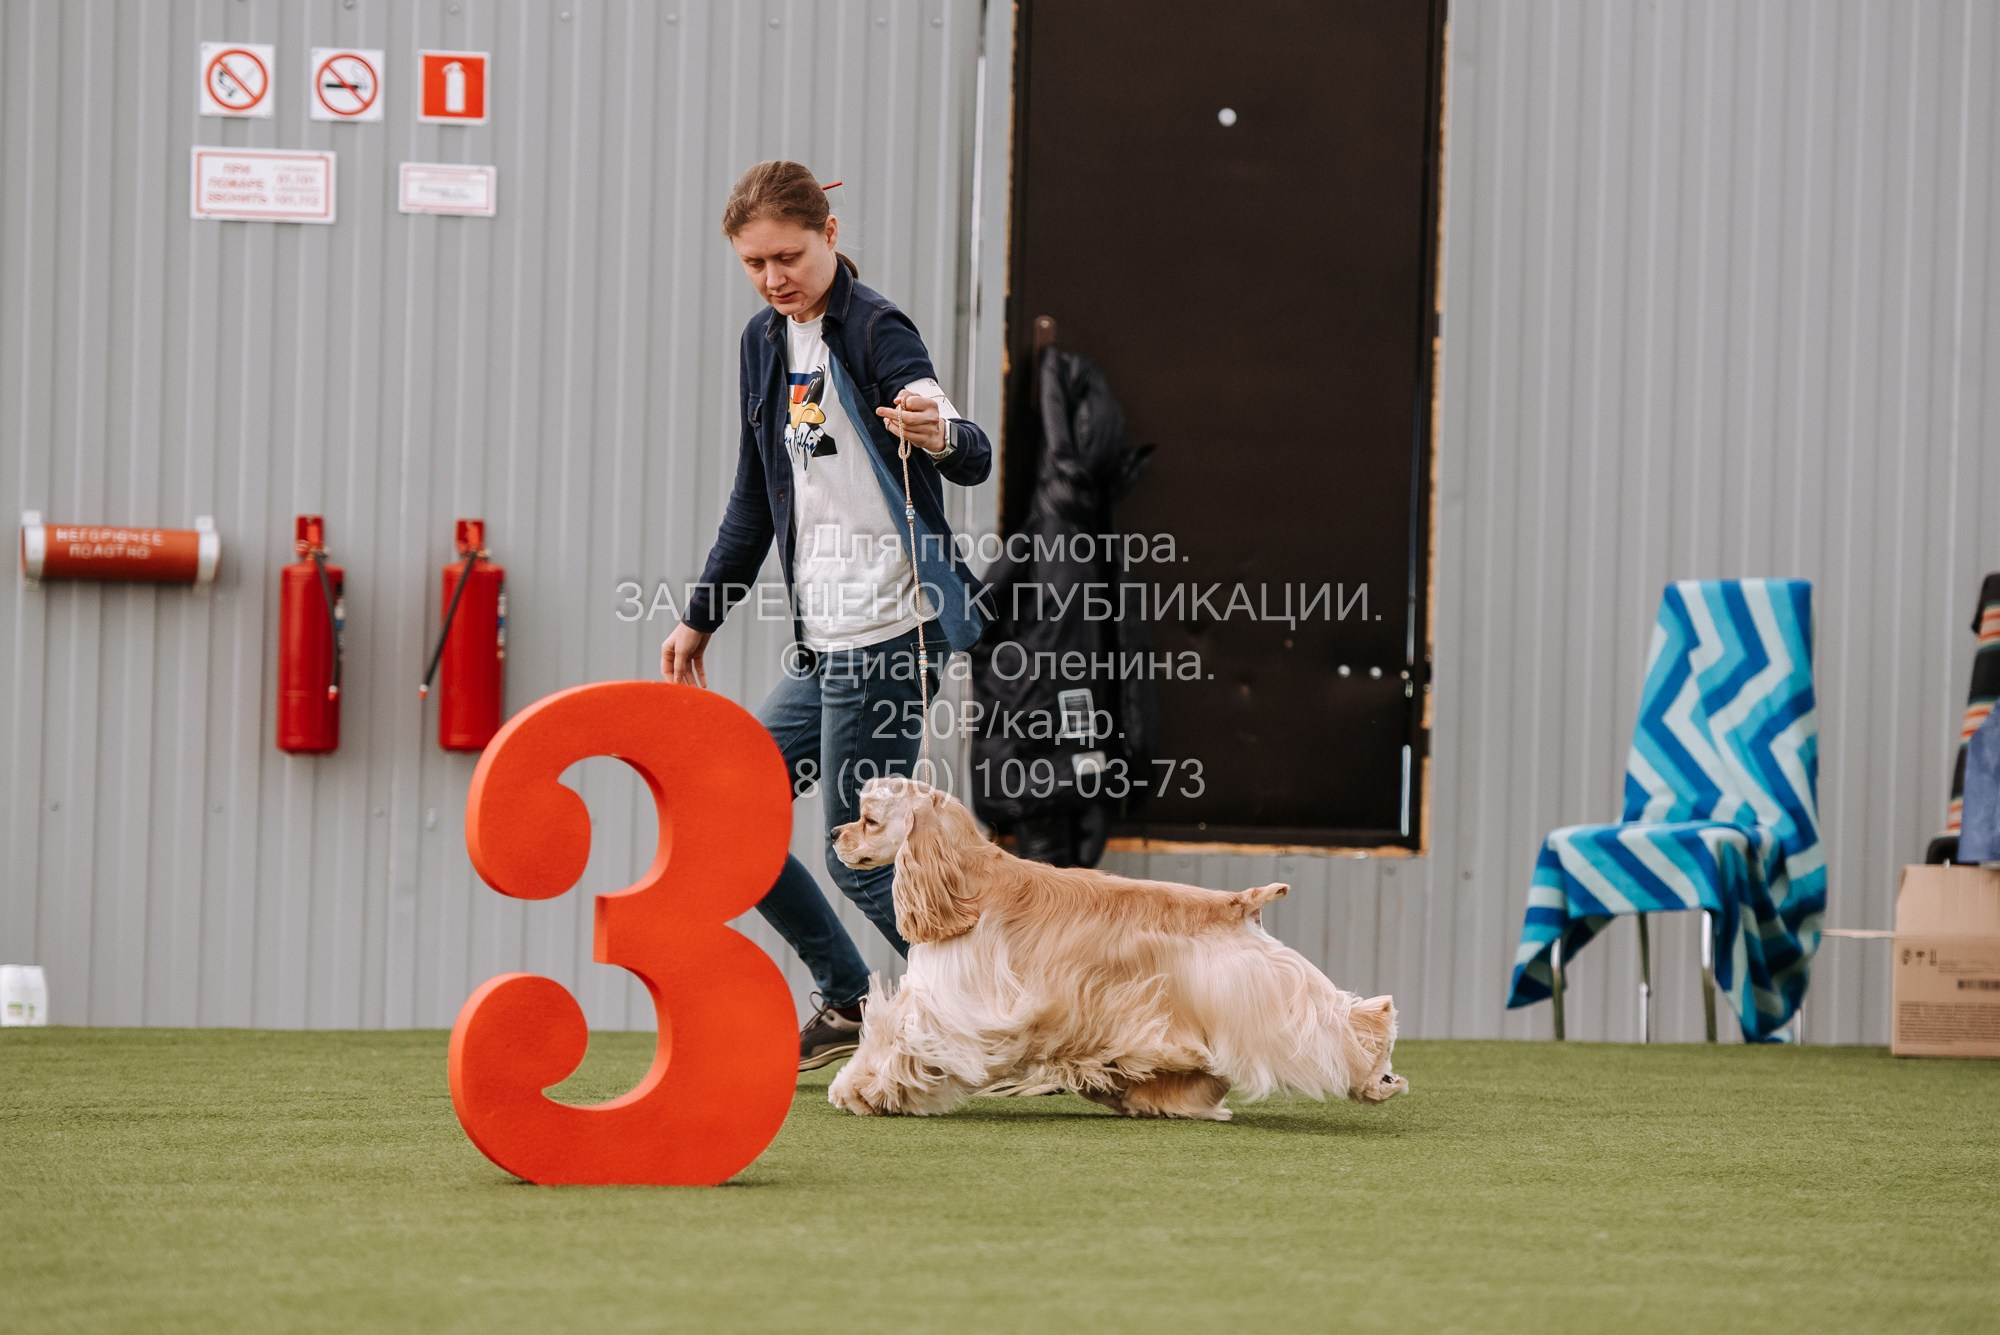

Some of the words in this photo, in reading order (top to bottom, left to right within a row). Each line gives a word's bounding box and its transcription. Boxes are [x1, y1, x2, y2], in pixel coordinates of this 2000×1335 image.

[55, 528, 164, 547] НЕГОРЮЧЕЕ
[69, 543, 151, 560] ПОЛОТНО
[448, 680, 800, 1187] 3
